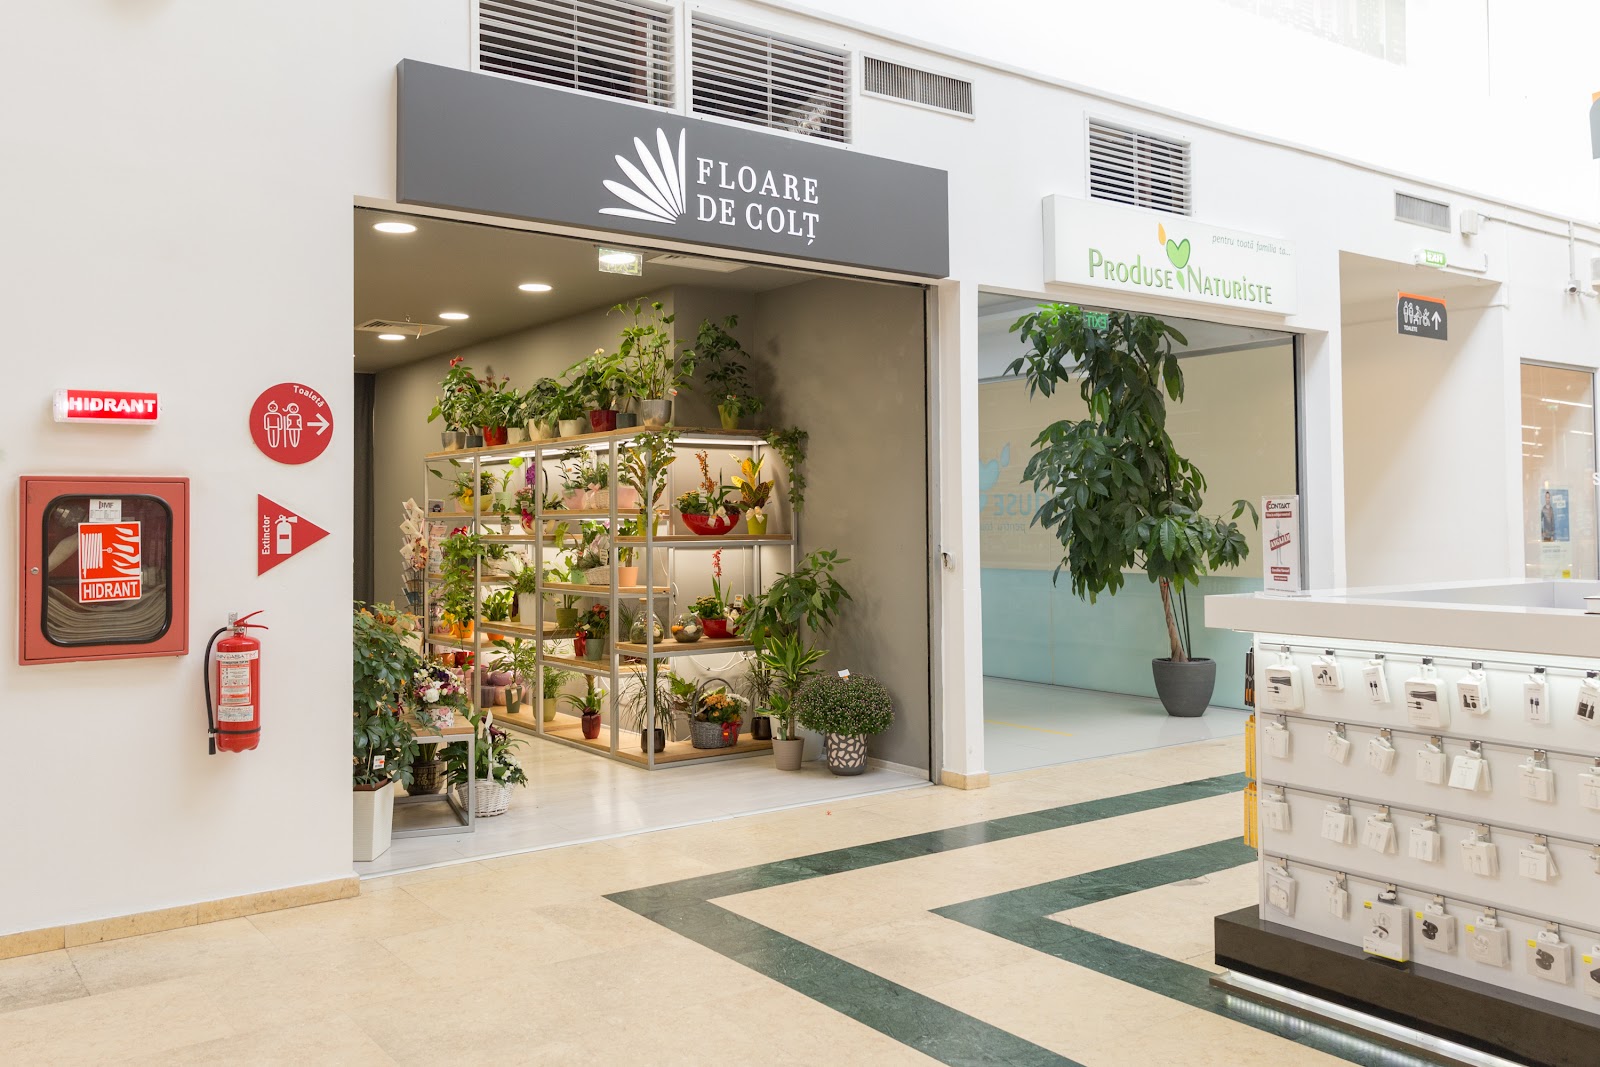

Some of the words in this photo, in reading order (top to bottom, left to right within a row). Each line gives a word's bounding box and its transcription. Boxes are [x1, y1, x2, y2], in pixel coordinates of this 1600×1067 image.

[696, 157, 819, 205] FLOARE
[696, 194, 736, 226] DE
[745, 203, 820, 246] COLȚ
[1212, 235, 1234, 246] pentru
[1256, 241, 1277, 254] familia
[68, 396, 157, 414] HIDRANT
[260, 514, 271, 556] Extinctor
[83, 580, 138, 599] HIDRANT
